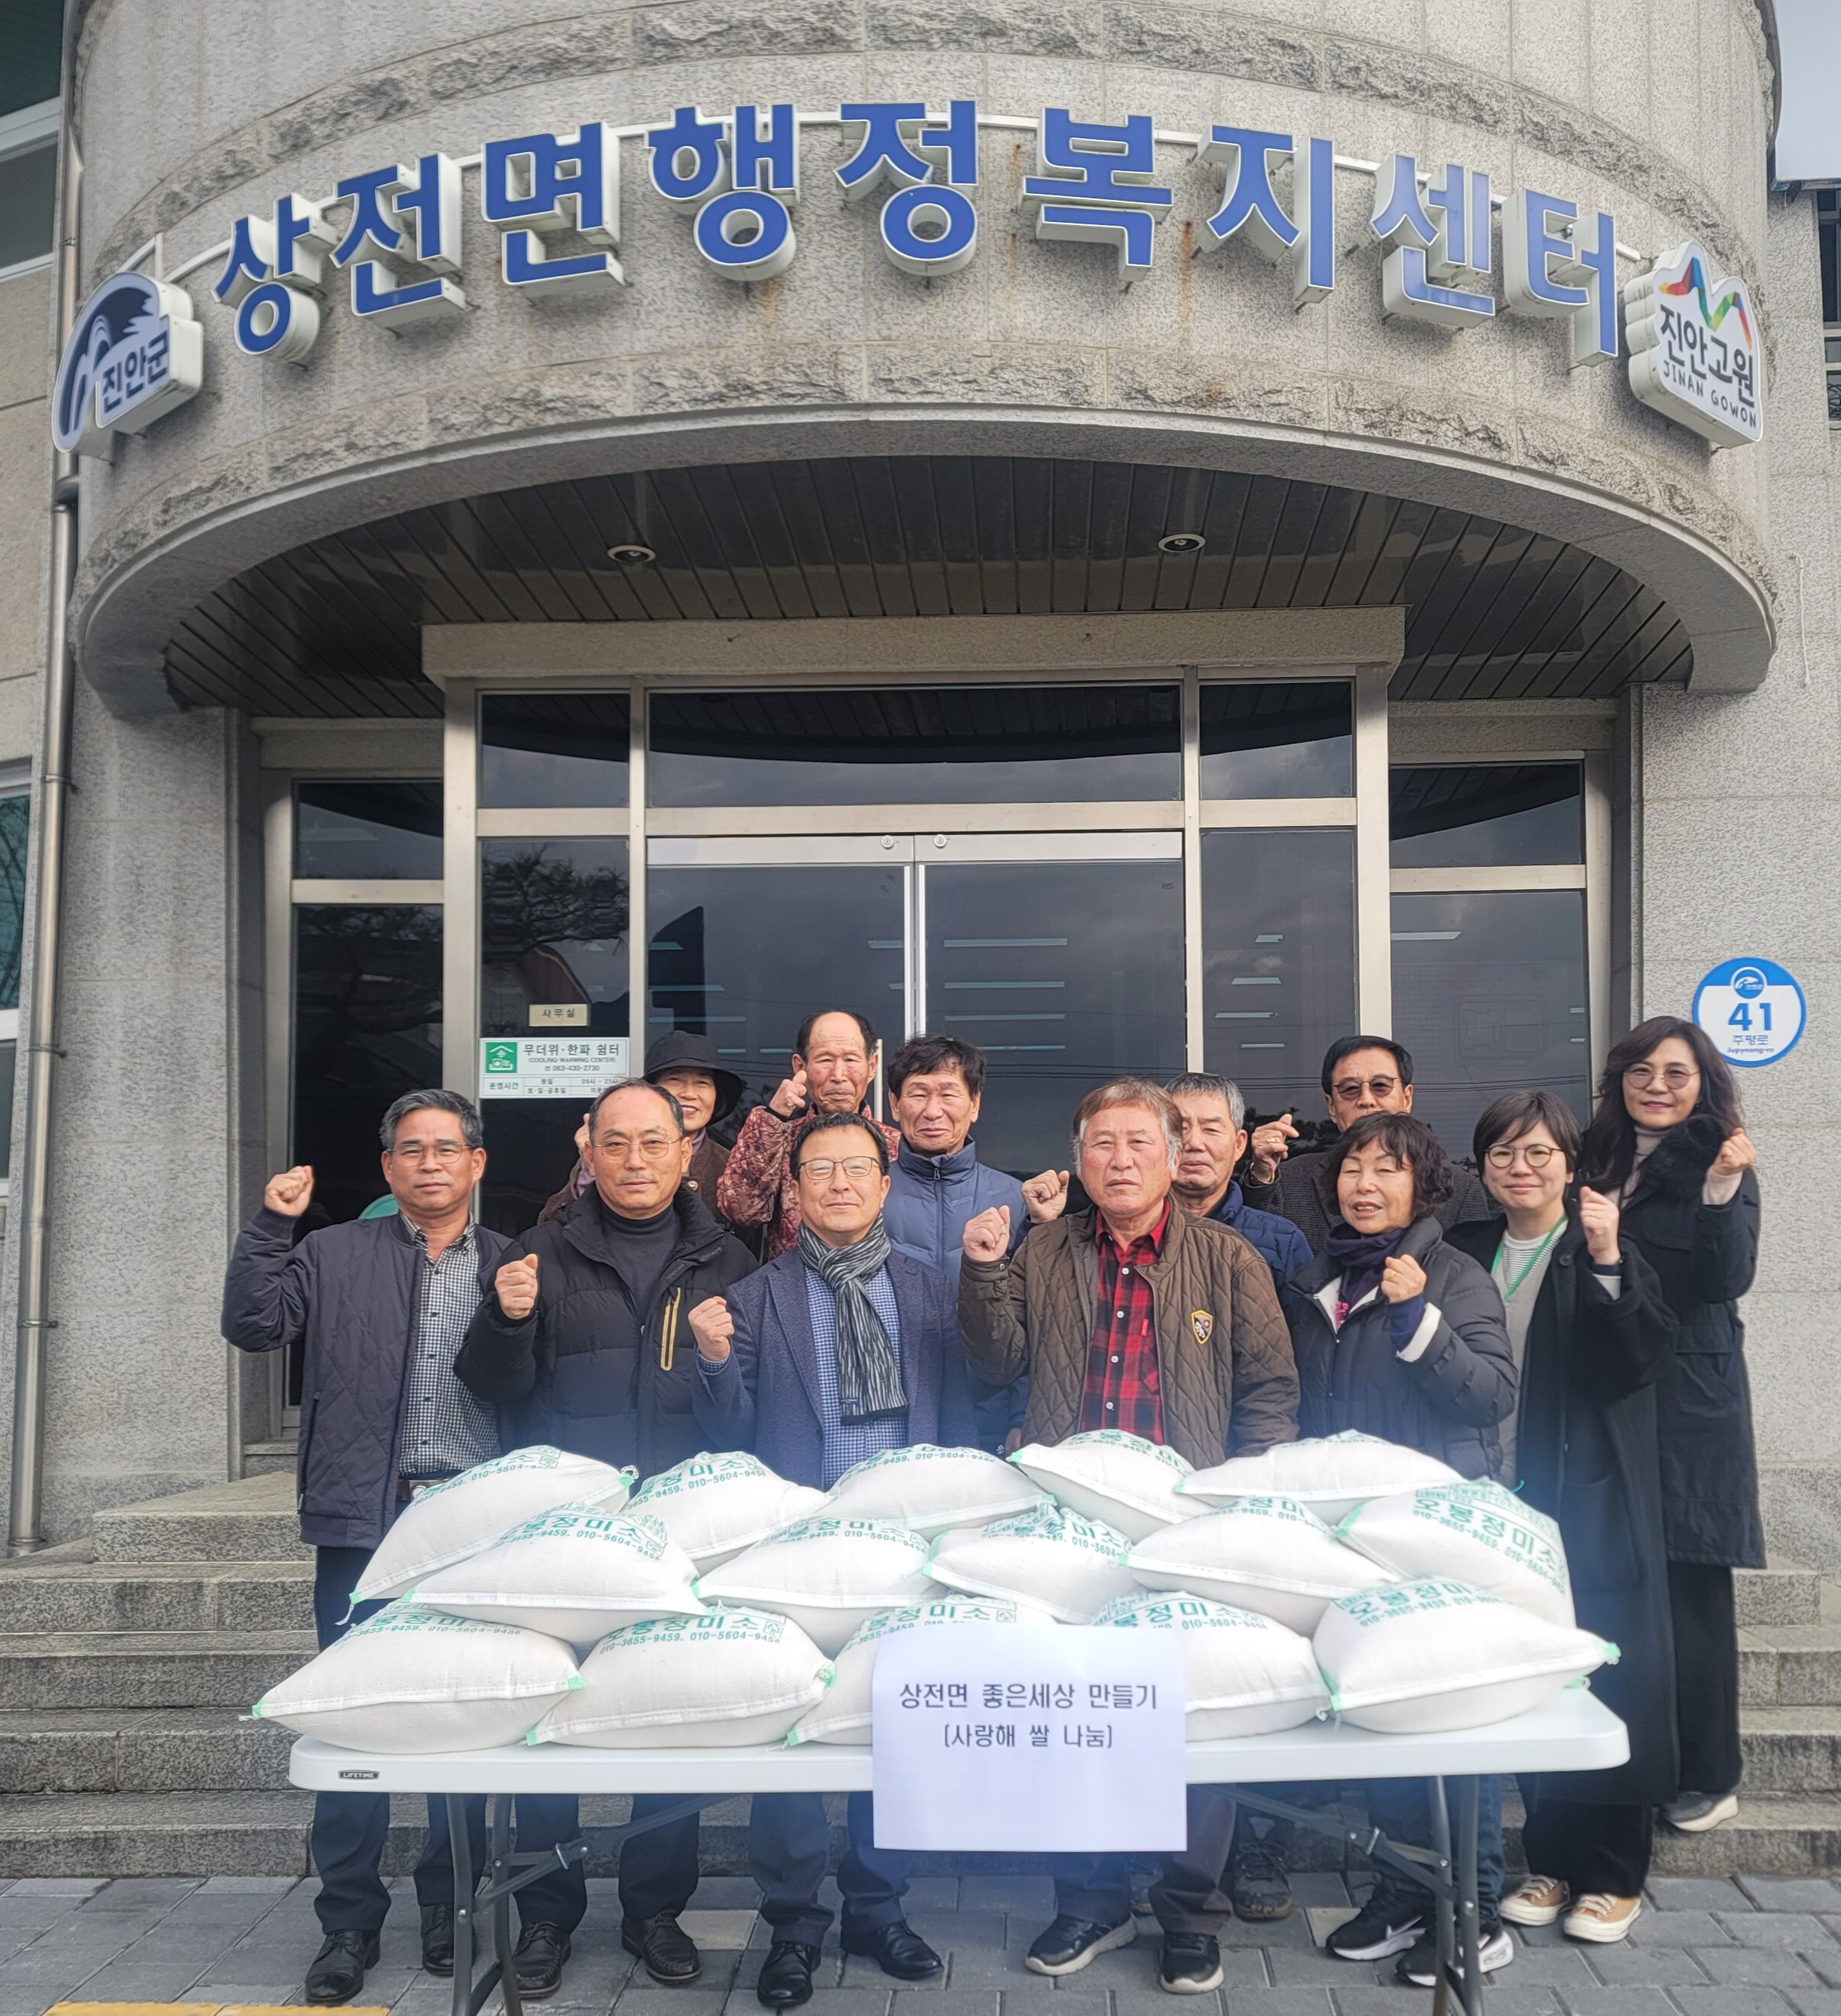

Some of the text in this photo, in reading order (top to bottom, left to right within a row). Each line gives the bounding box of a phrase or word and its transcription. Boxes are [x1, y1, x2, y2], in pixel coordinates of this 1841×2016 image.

[214, 100, 1618, 358] 상전면행정복지센터
[1661, 303, 1754, 408] 진안고원
[103, 330, 168, 414] 진안군
[1663, 359, 1757, 428] JINAN GOWON
[541, 1008, 576, 1018] 사무실
[1728, 1002, 1773, 1031] 41
[596, 1043, 620, 1056] 쉼터
[1732, 1034, 1769, 1046] 주평로
[1113, 1602, 1240, 1627] 봉정미소
[900, 1683, 1157, 1710] 상전면 좋은세상 만들기
[1029, 1724, 1050, 1748] 쌀
